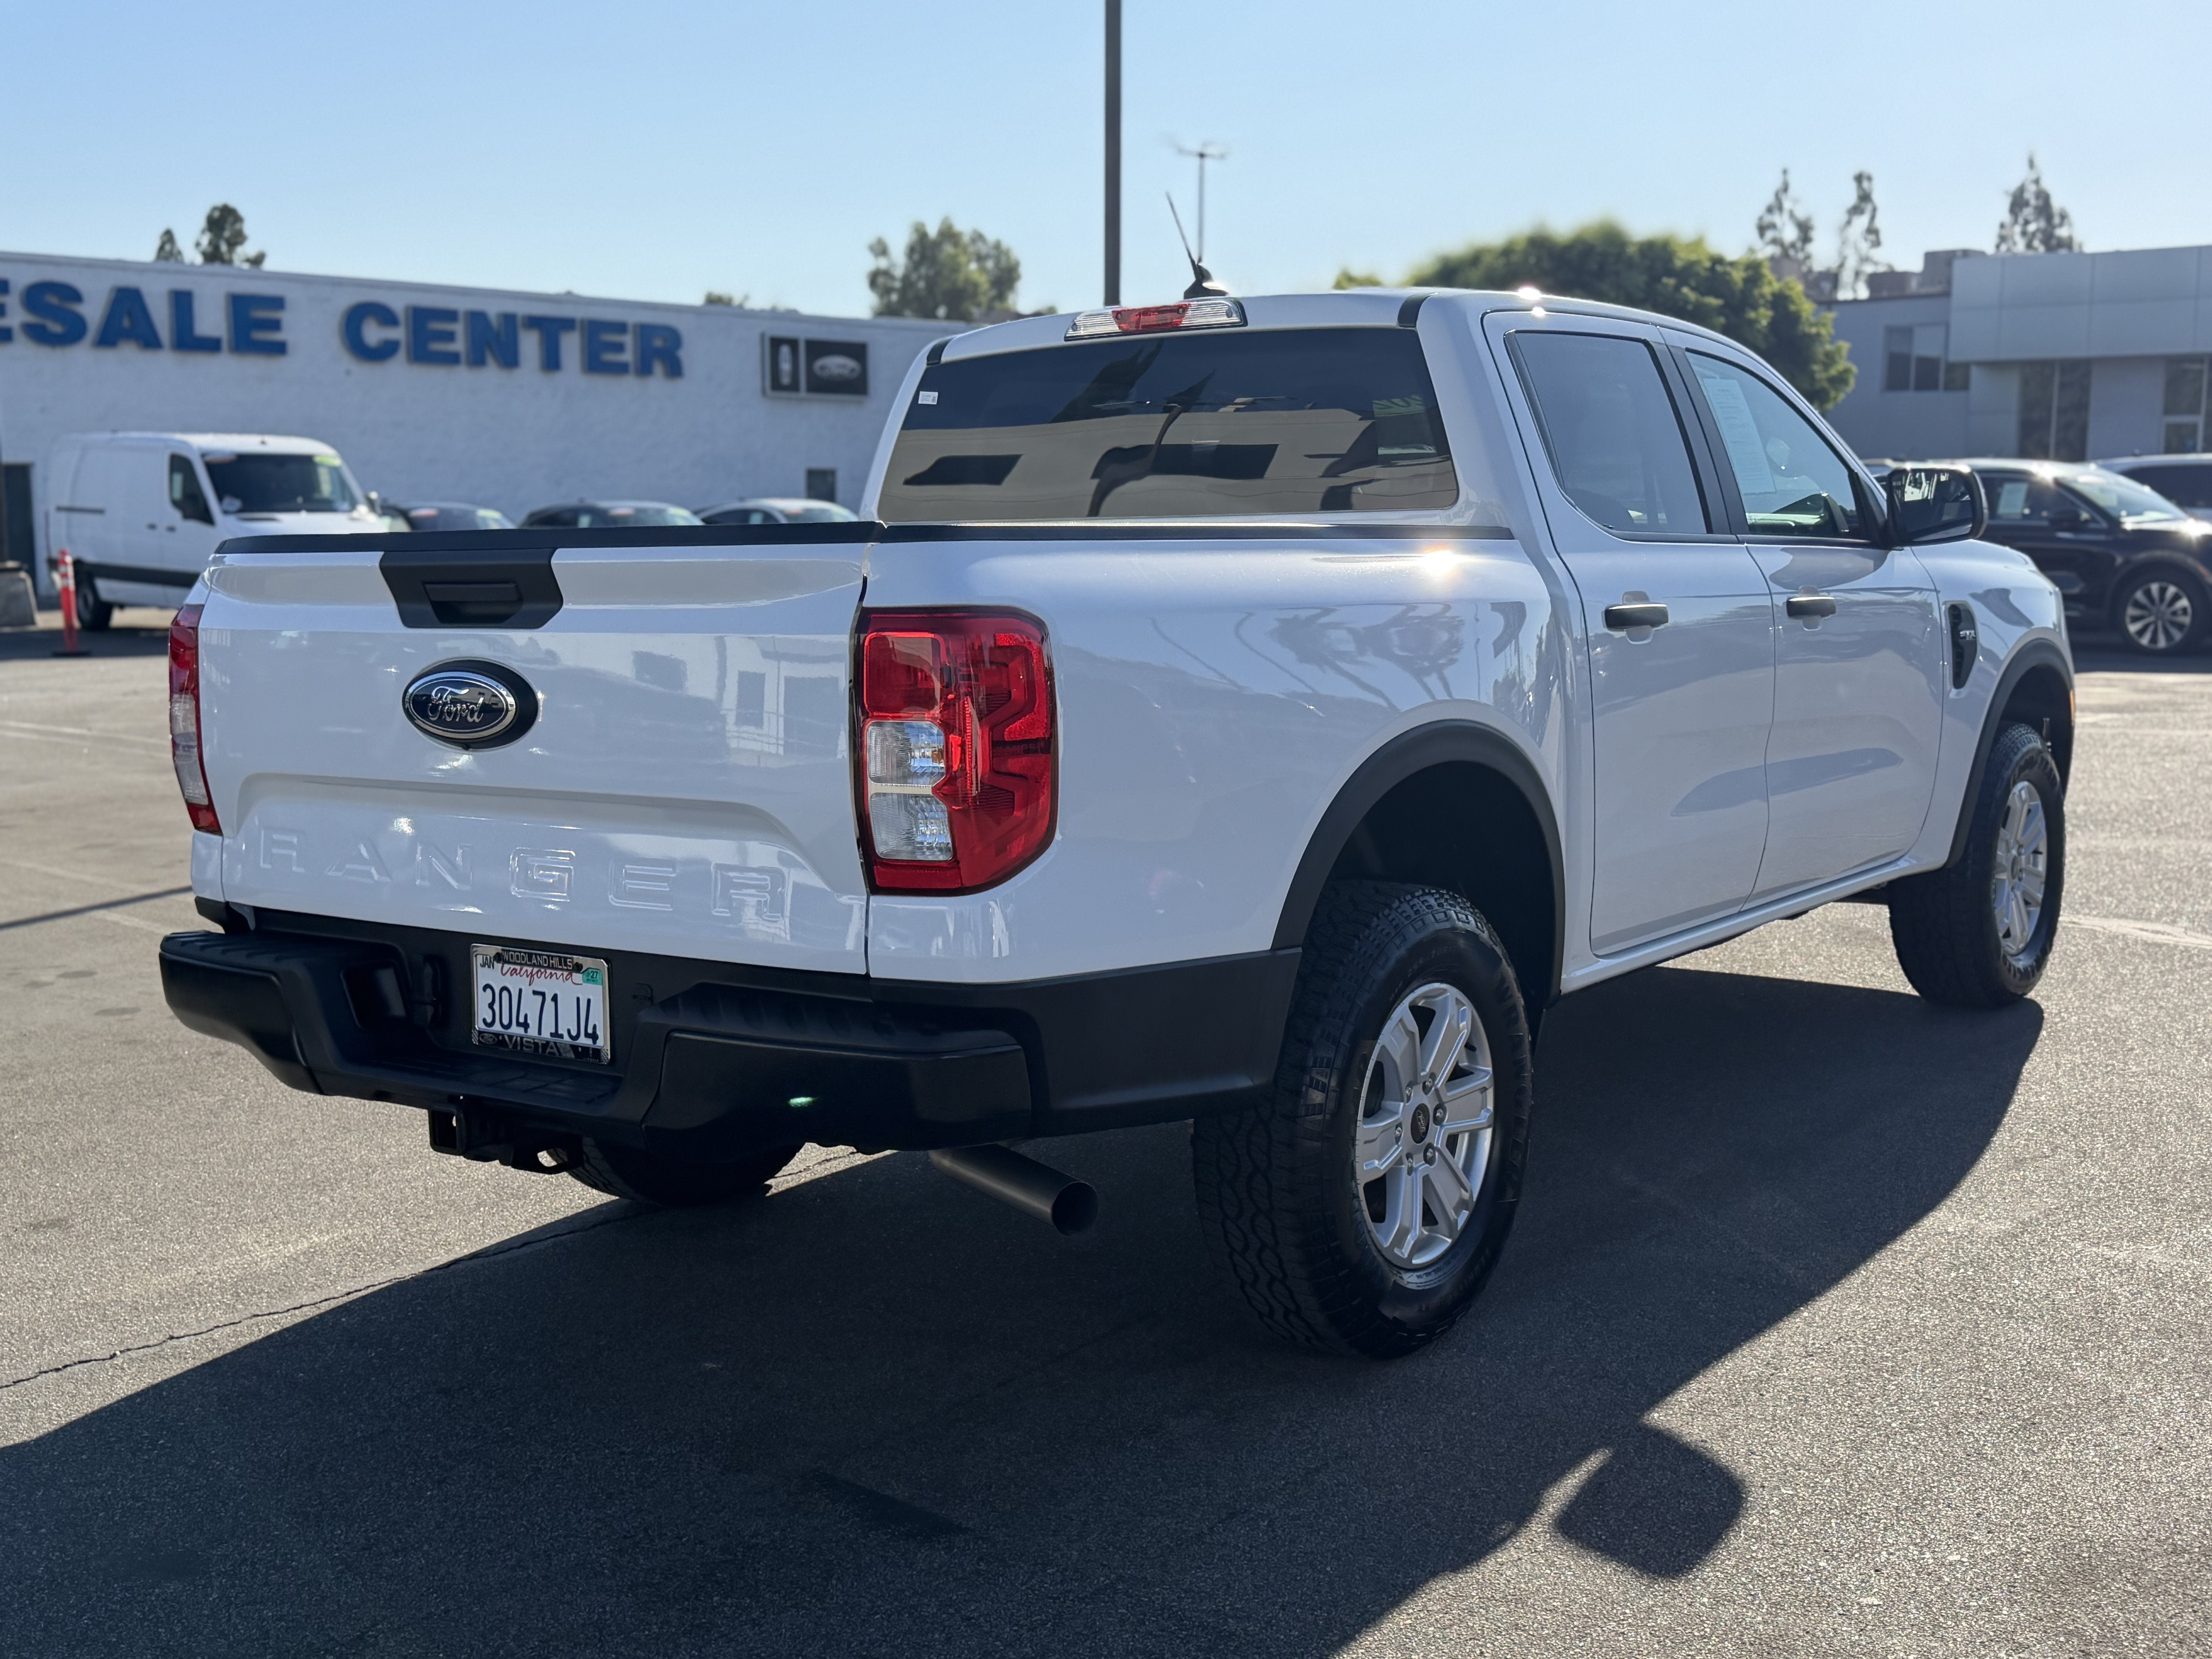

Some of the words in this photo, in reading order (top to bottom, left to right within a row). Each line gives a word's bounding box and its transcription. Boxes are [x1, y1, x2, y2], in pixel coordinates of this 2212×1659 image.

[0, 279, 287, 356] SALE
[341, 301, 684, 378] CENTER
[428, 686, 484, 723] Ford
[260, 827, 786, 922] RANGER
[480, 955, 495, 969] JAN
[500, 963, 583, 986] California
[503, 950, 548, 967] WOODLAND
[550, 957, 573, 970] HILLS
[482, 983, 599, 1045] 30471J4
[504, 1035, 559, 1056] VISTA
